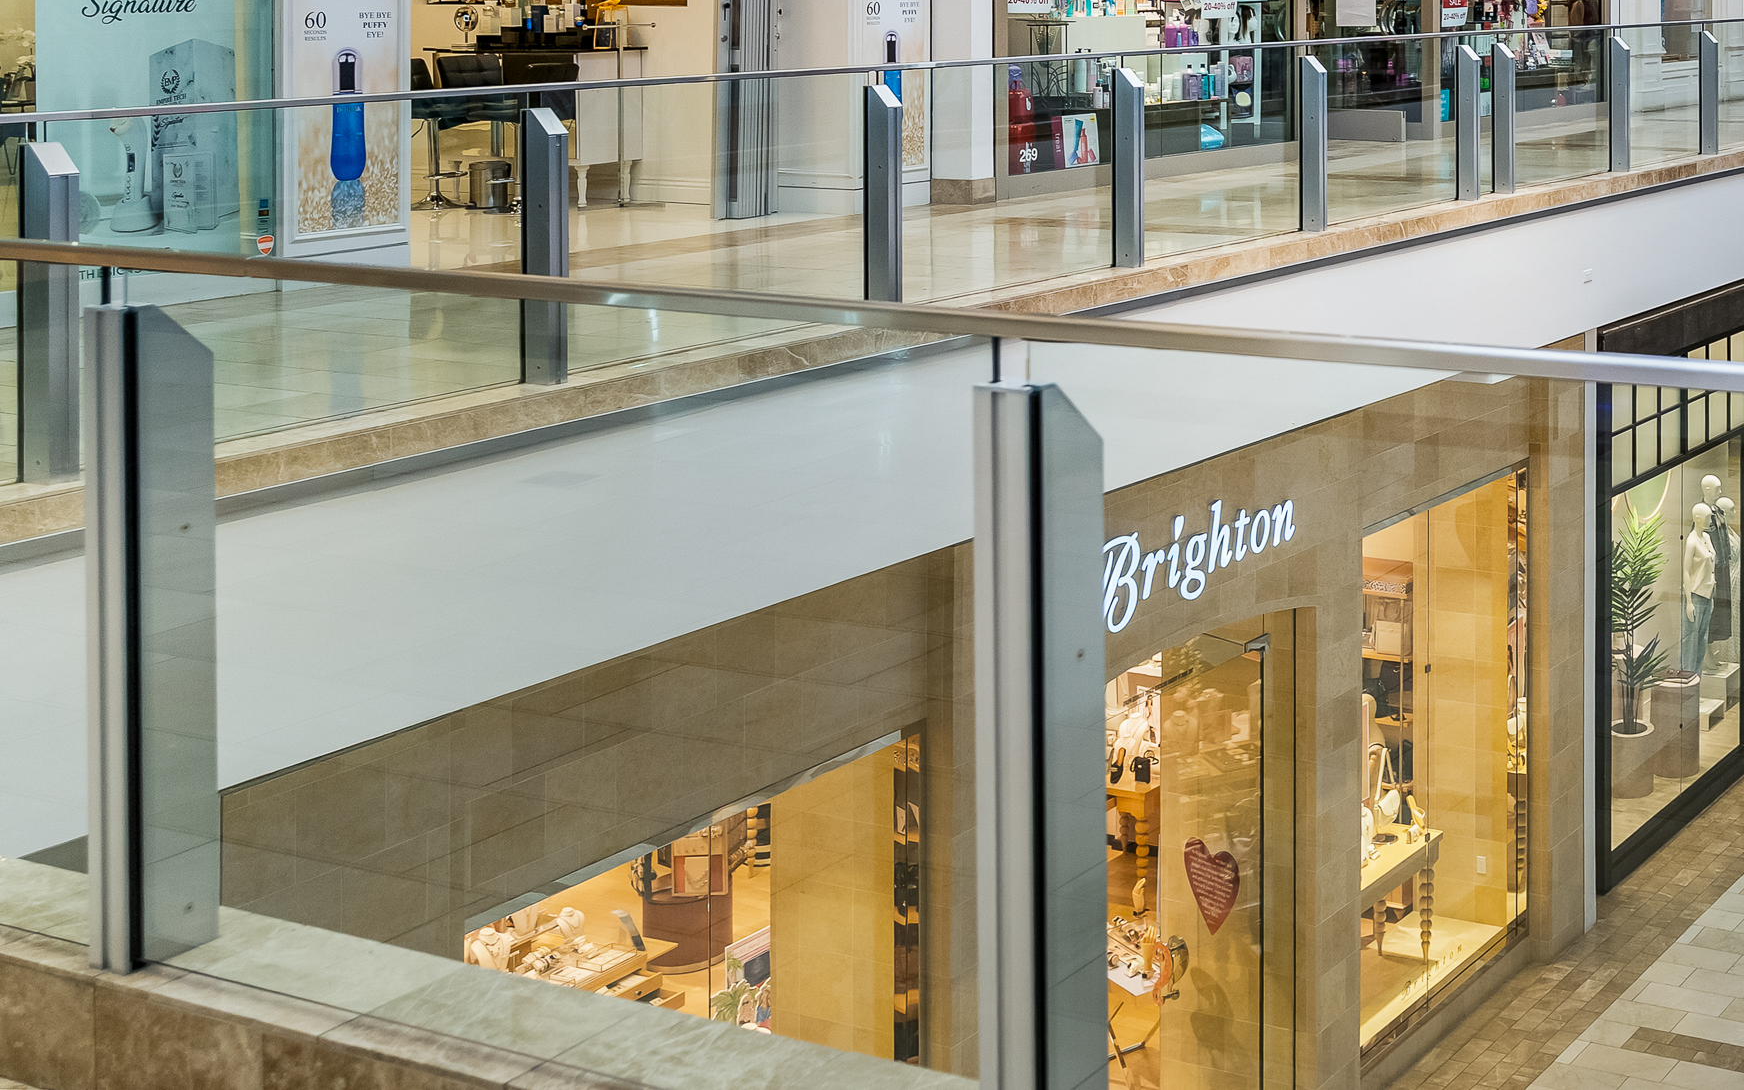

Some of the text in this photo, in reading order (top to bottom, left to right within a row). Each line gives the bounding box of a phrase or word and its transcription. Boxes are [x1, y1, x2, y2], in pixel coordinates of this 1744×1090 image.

[867, 1, 880, 15] 60
[1204, 1, 1236, 10] 20-40% off
[305, 11, 327, 28] 60
[1020, 148, 1038, 162] 269
[1102, 499, 1296, 633] Brighton
